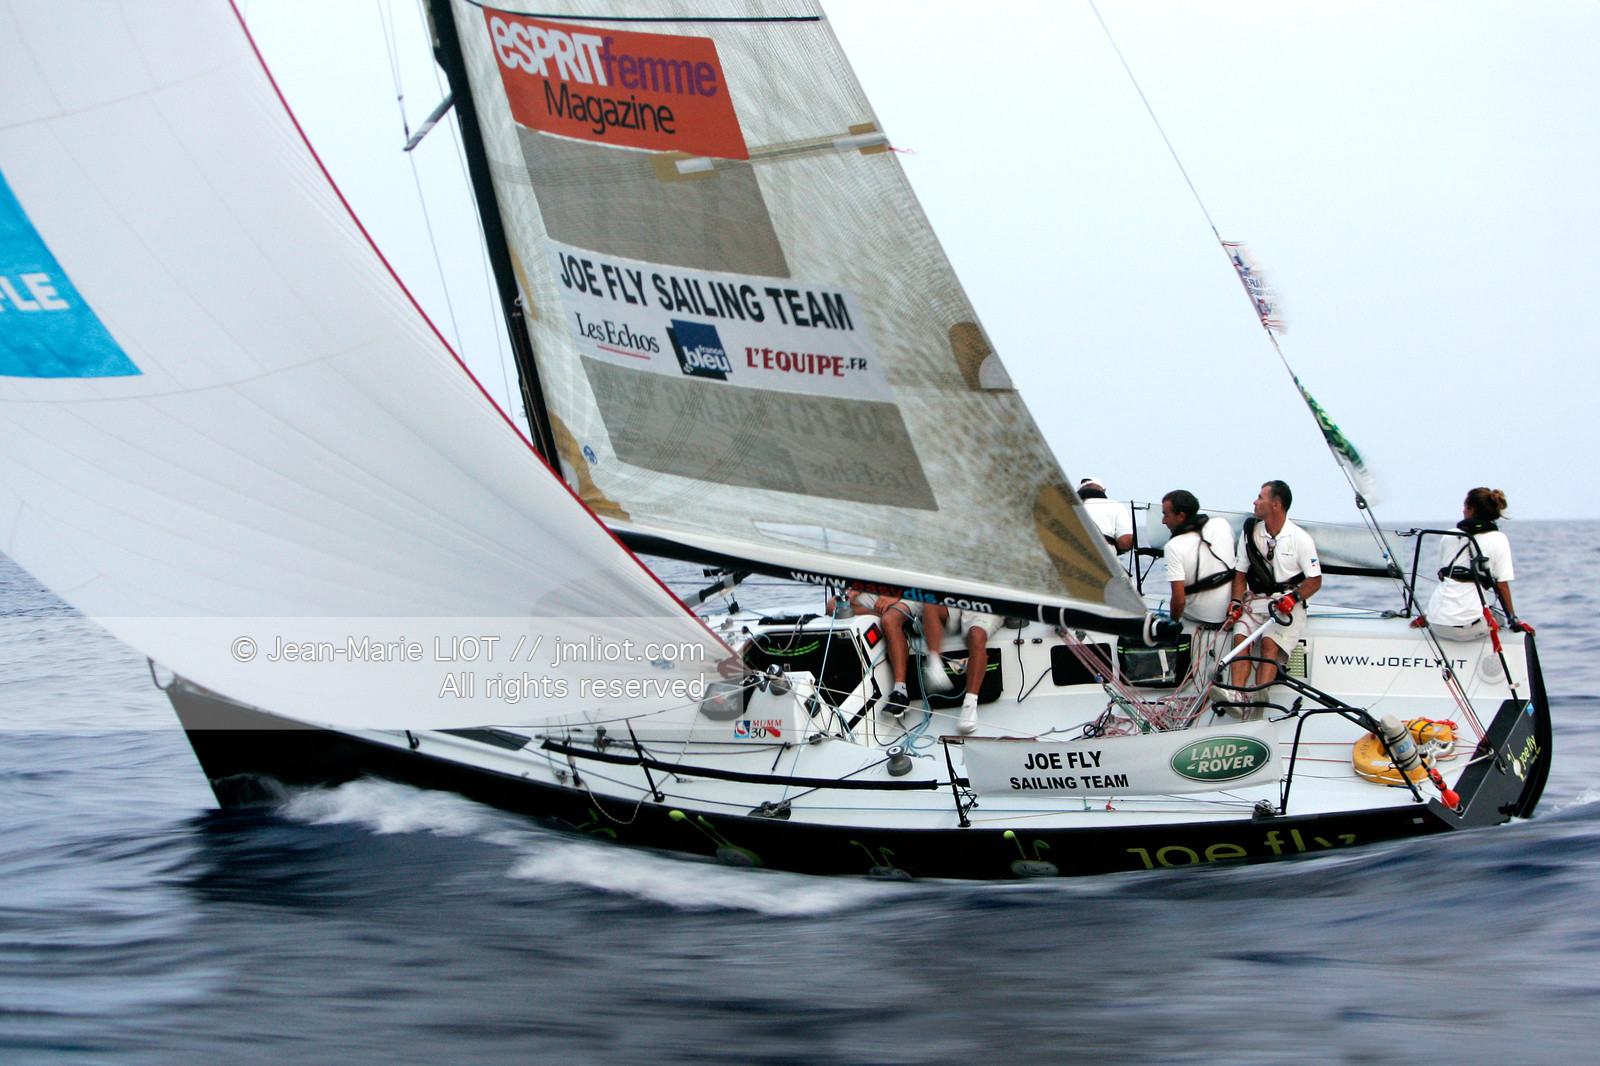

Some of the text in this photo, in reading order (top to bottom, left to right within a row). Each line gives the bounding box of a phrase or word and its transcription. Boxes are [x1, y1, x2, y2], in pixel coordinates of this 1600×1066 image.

[543, 79, 676, 135] Magazine
[0, 272, 71, 311] LE
[558, 251, 855, 331] JOE FLY SAILING TEAM
[682, 345, 731, 373] bleu
[750, 727, 767, 739] 30
[1024, 750, 1102, 770] JOE FLY
[1009, 774, 1129, 790] SAILING TEAM
